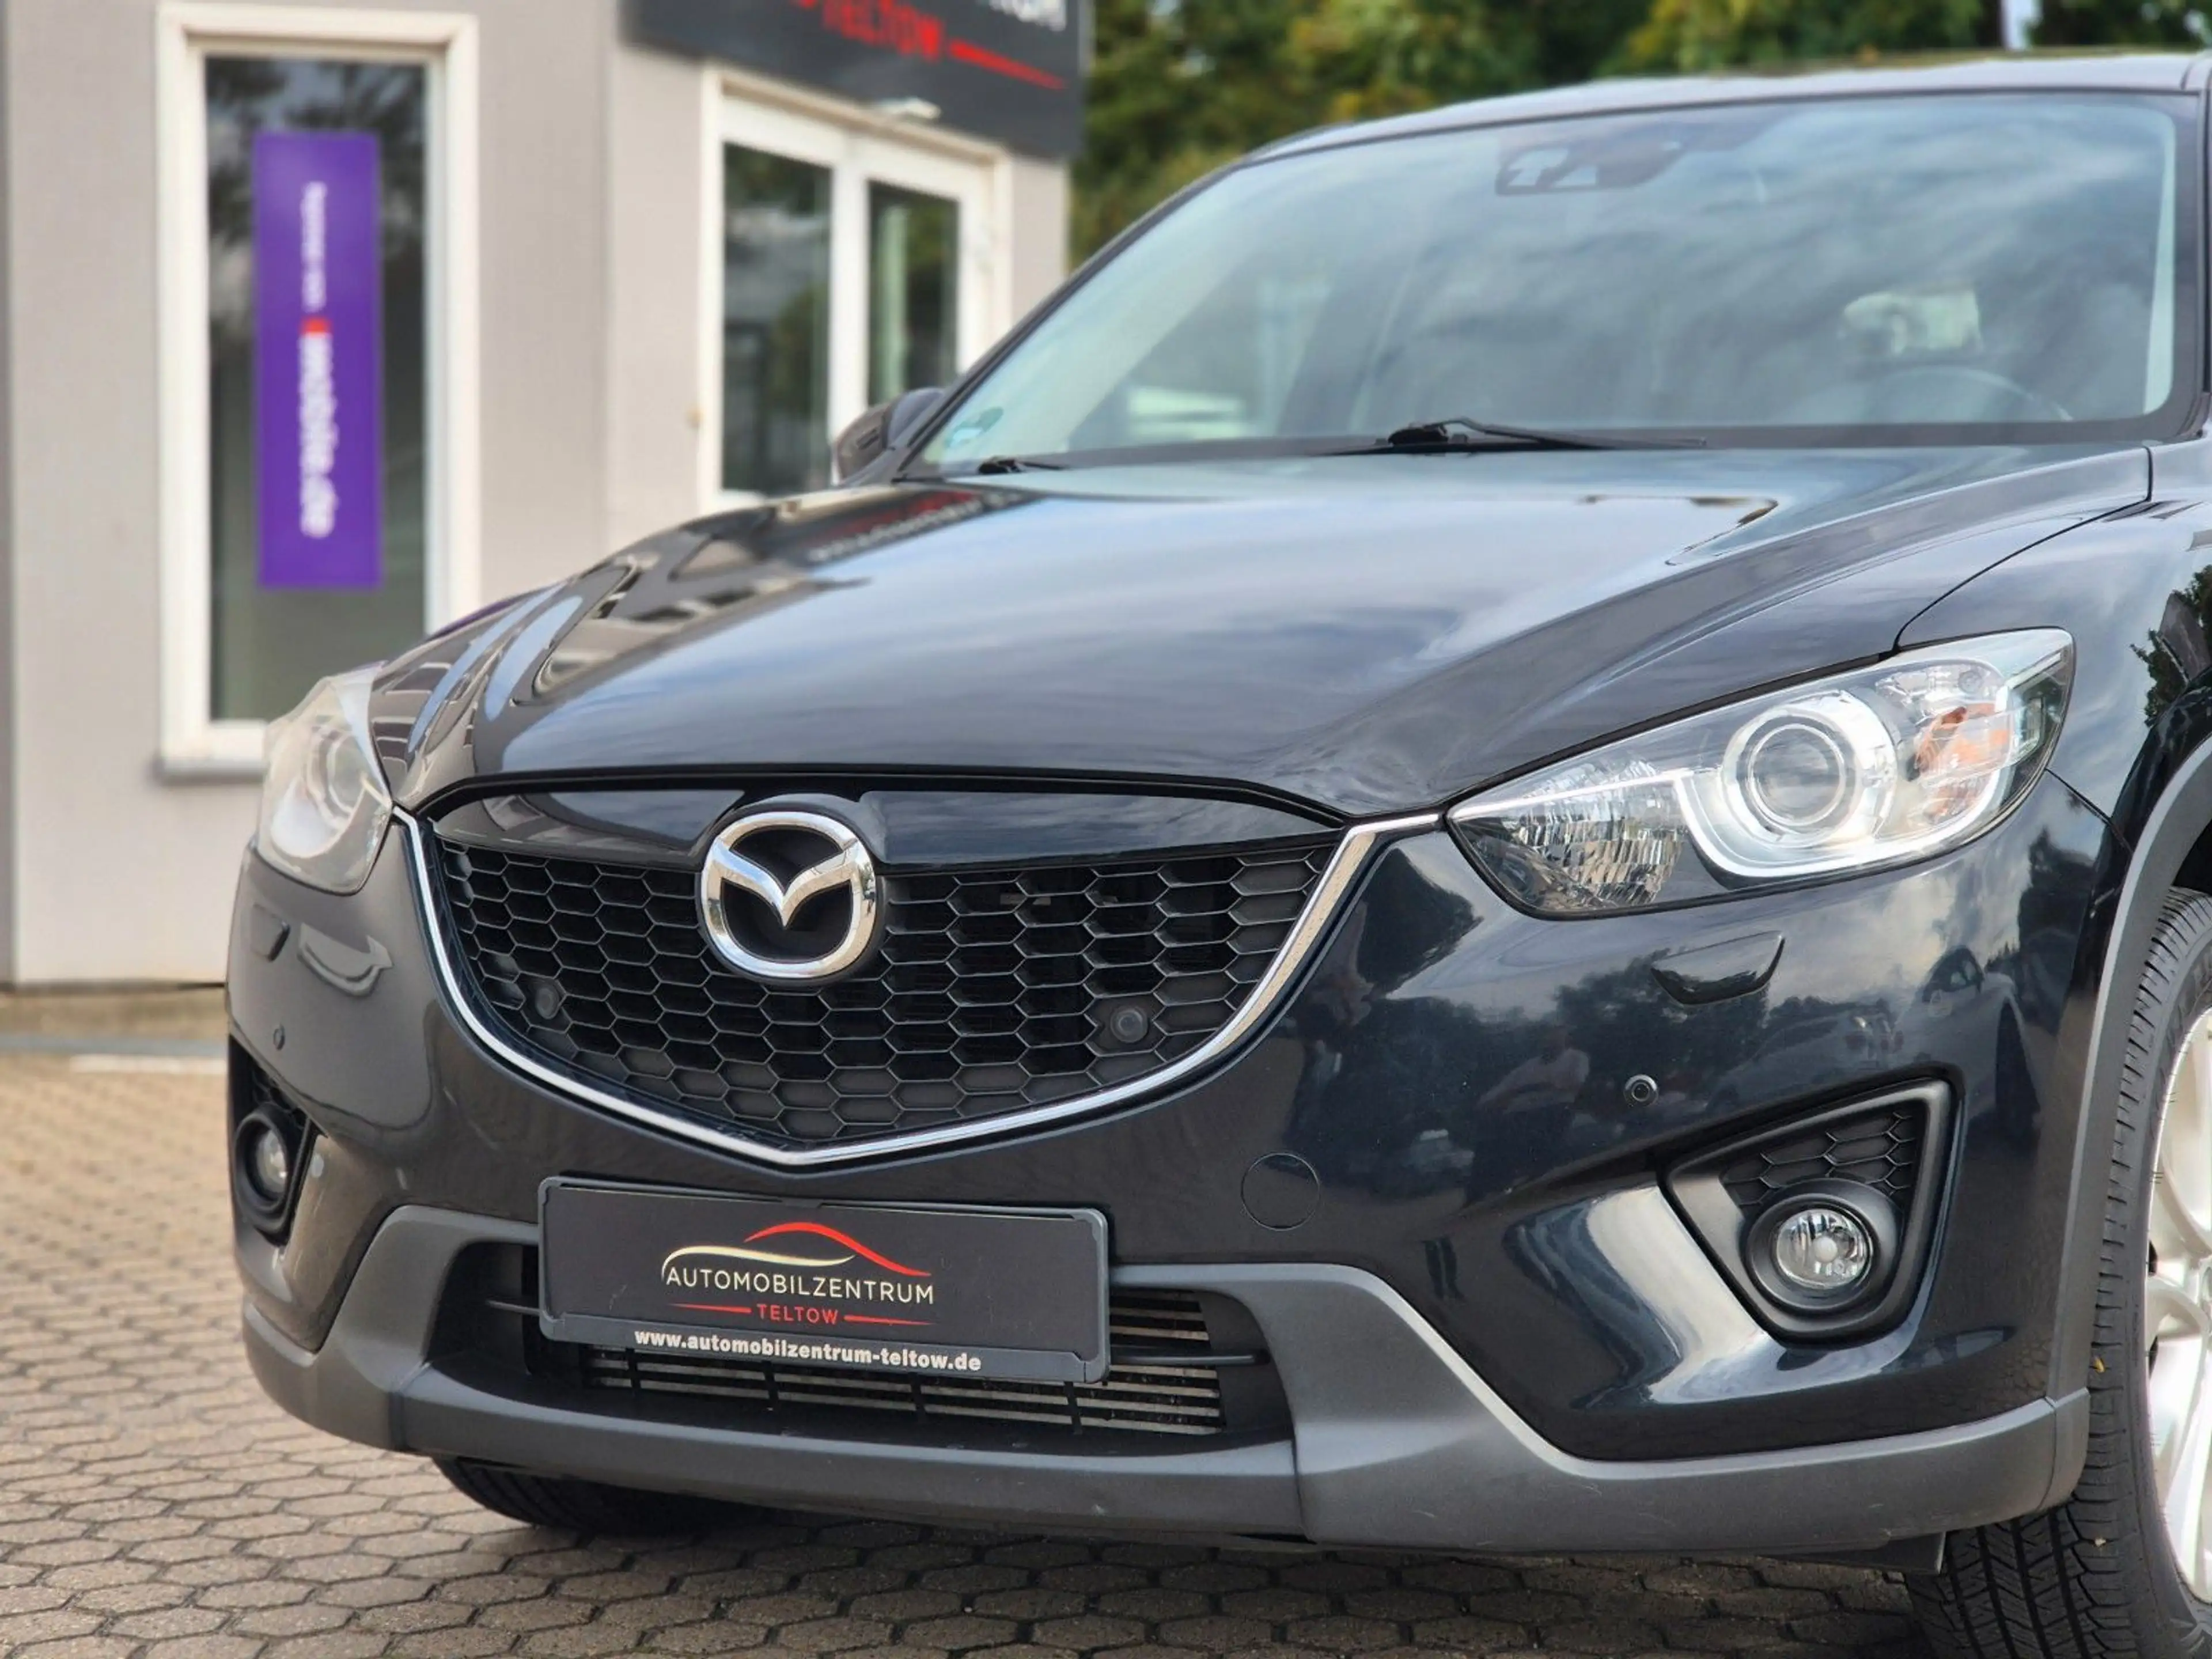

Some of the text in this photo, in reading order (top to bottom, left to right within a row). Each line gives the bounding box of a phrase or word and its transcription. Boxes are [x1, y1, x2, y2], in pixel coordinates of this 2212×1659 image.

[666, 1267, 934, 1304] AUTOMOBILZENTRUM
[757, 1304, 839, 1324] TELTOW
[635, 1330, 982, 1371] www.automobilzentrum-teltow.de
